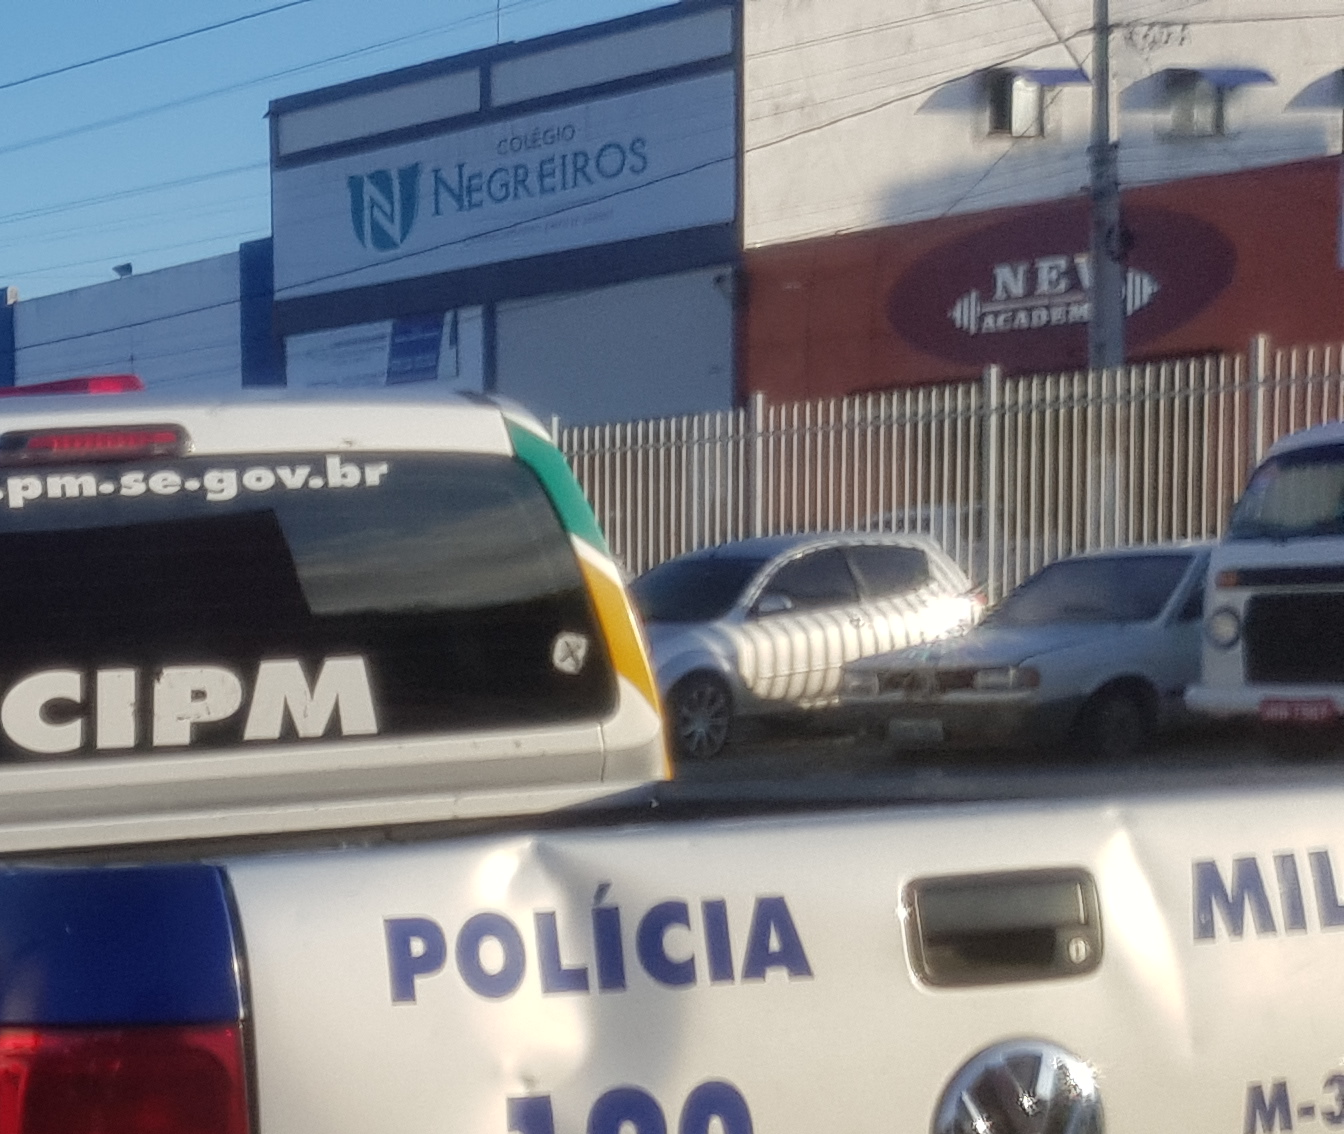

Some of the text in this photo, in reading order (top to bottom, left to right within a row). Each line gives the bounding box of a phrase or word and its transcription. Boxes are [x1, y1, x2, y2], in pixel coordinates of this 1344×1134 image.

[496, 123, 577, 156] COLÉGIO
[430, 137, 650, 217] NEGREIROS
[980, 302, 1092, 334] ACADEM
[383, 883, 815, 1005] POLÍCIA
